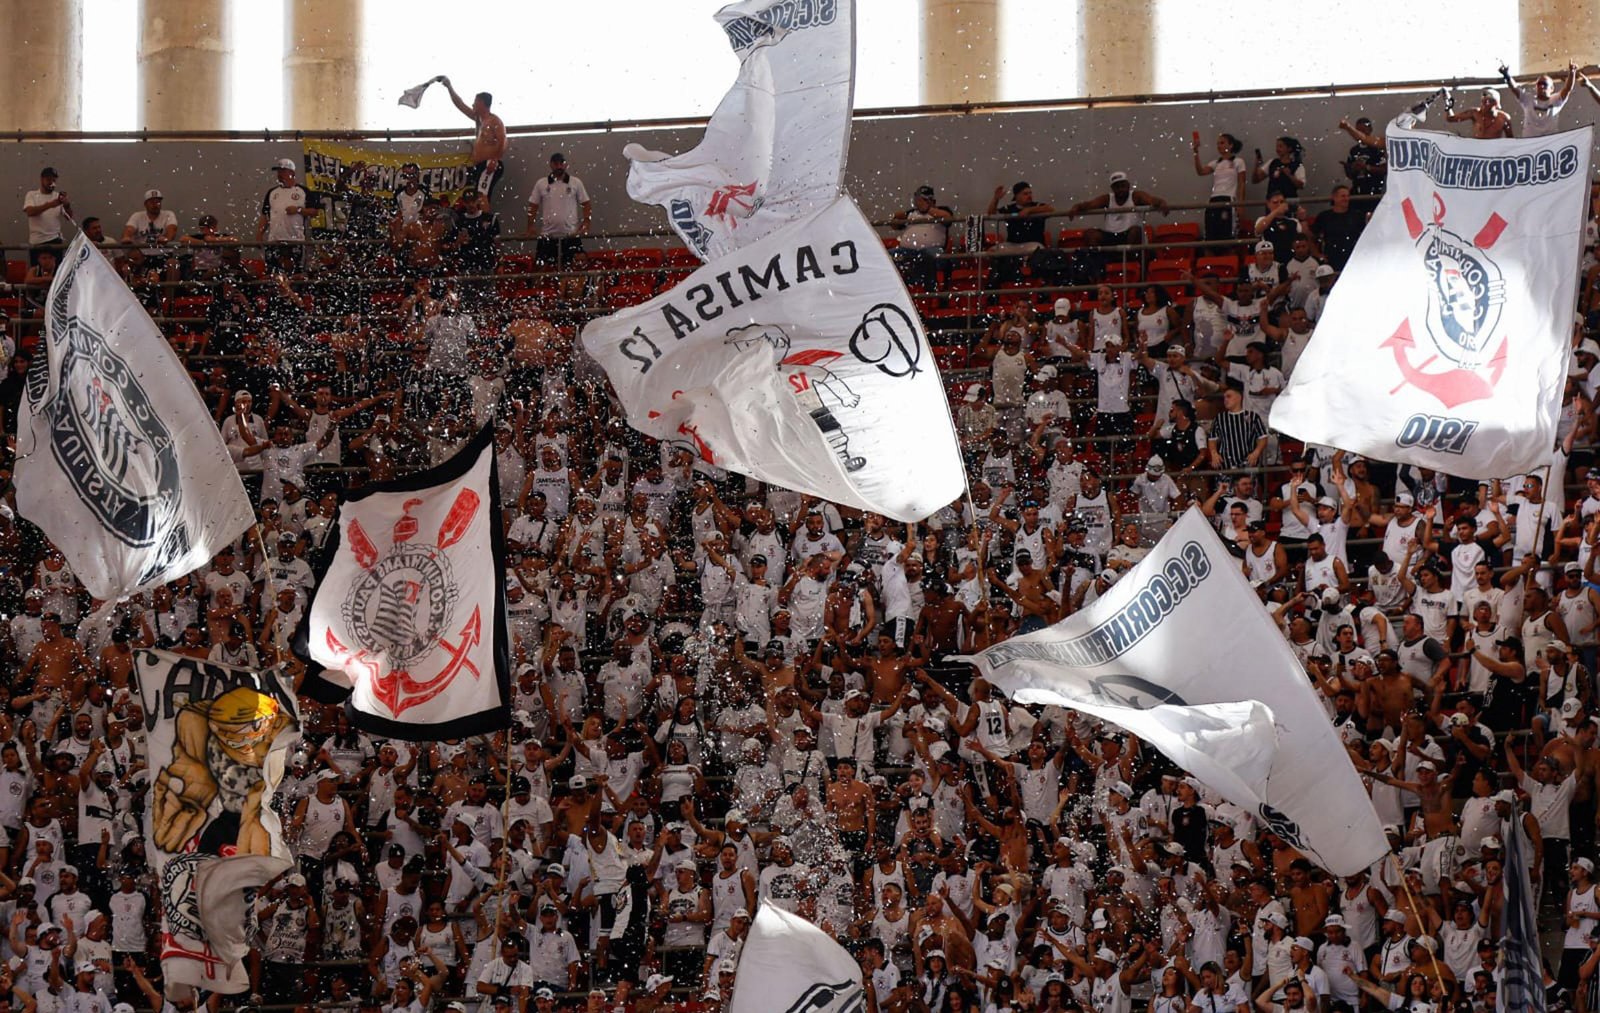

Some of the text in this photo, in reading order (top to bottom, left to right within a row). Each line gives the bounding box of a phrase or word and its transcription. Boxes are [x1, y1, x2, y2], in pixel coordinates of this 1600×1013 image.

[309, 151, 341, 179] FIEL
[986, 717, 1001, 735] 12
[168, 908, 192, 928] 1910
